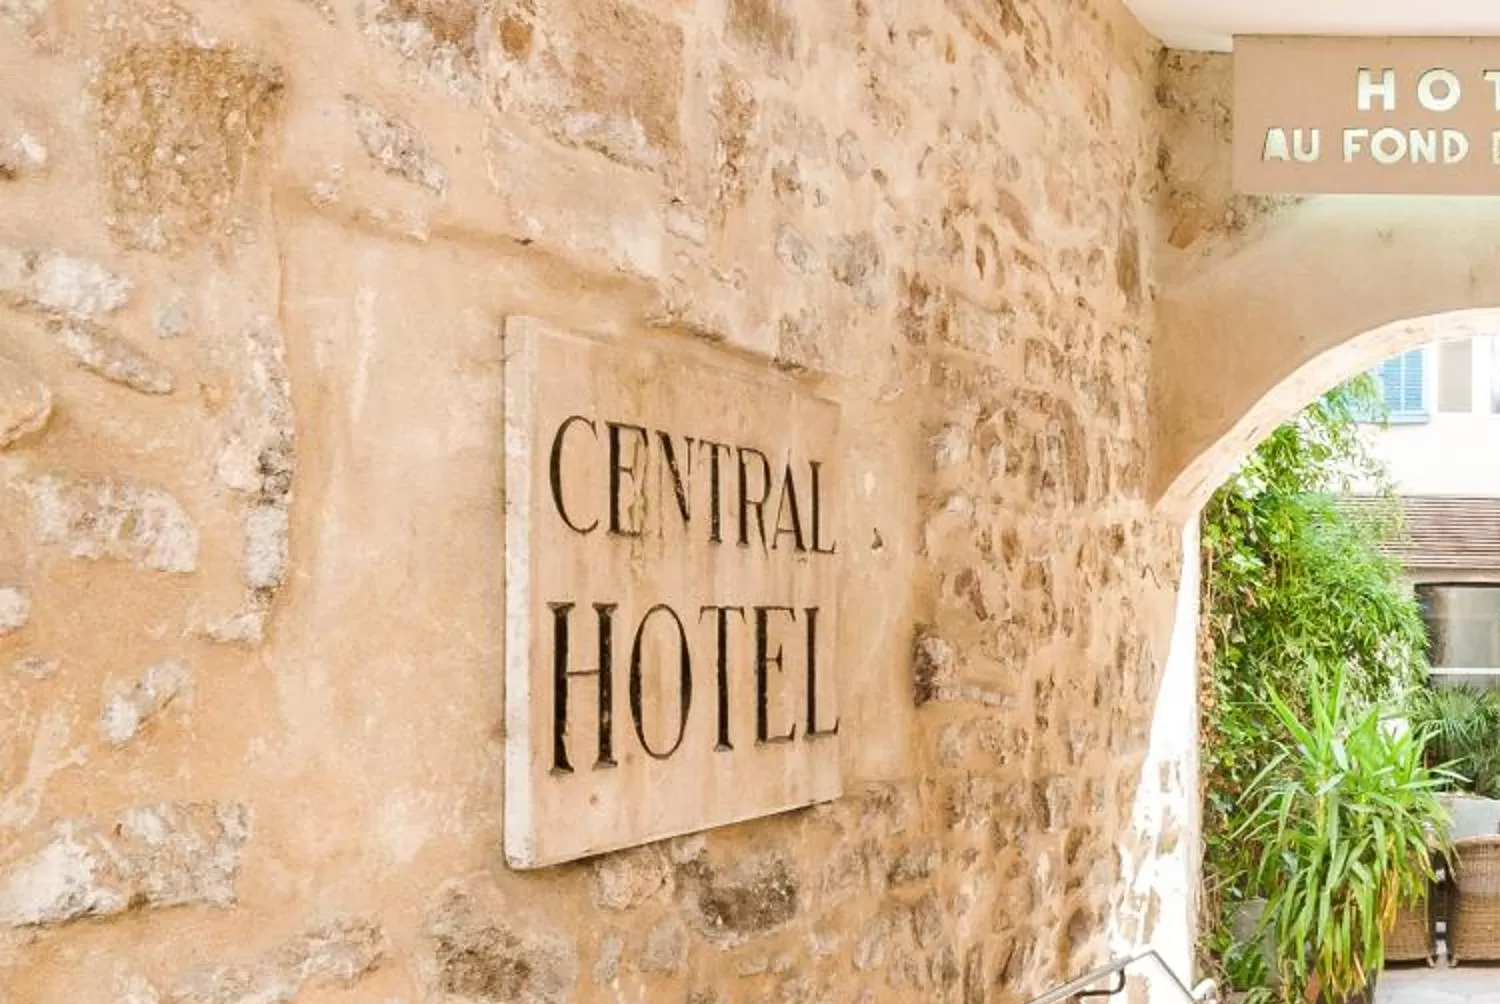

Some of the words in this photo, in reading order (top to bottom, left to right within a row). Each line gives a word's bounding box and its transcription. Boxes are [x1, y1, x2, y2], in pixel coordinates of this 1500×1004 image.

[1261, 127, 1320, 162] AU
[1342, 126, 1470, 164] FOND
[548, 414, 837, 559] CENTRAL
[546, 601, 840, 776] HOTEL
